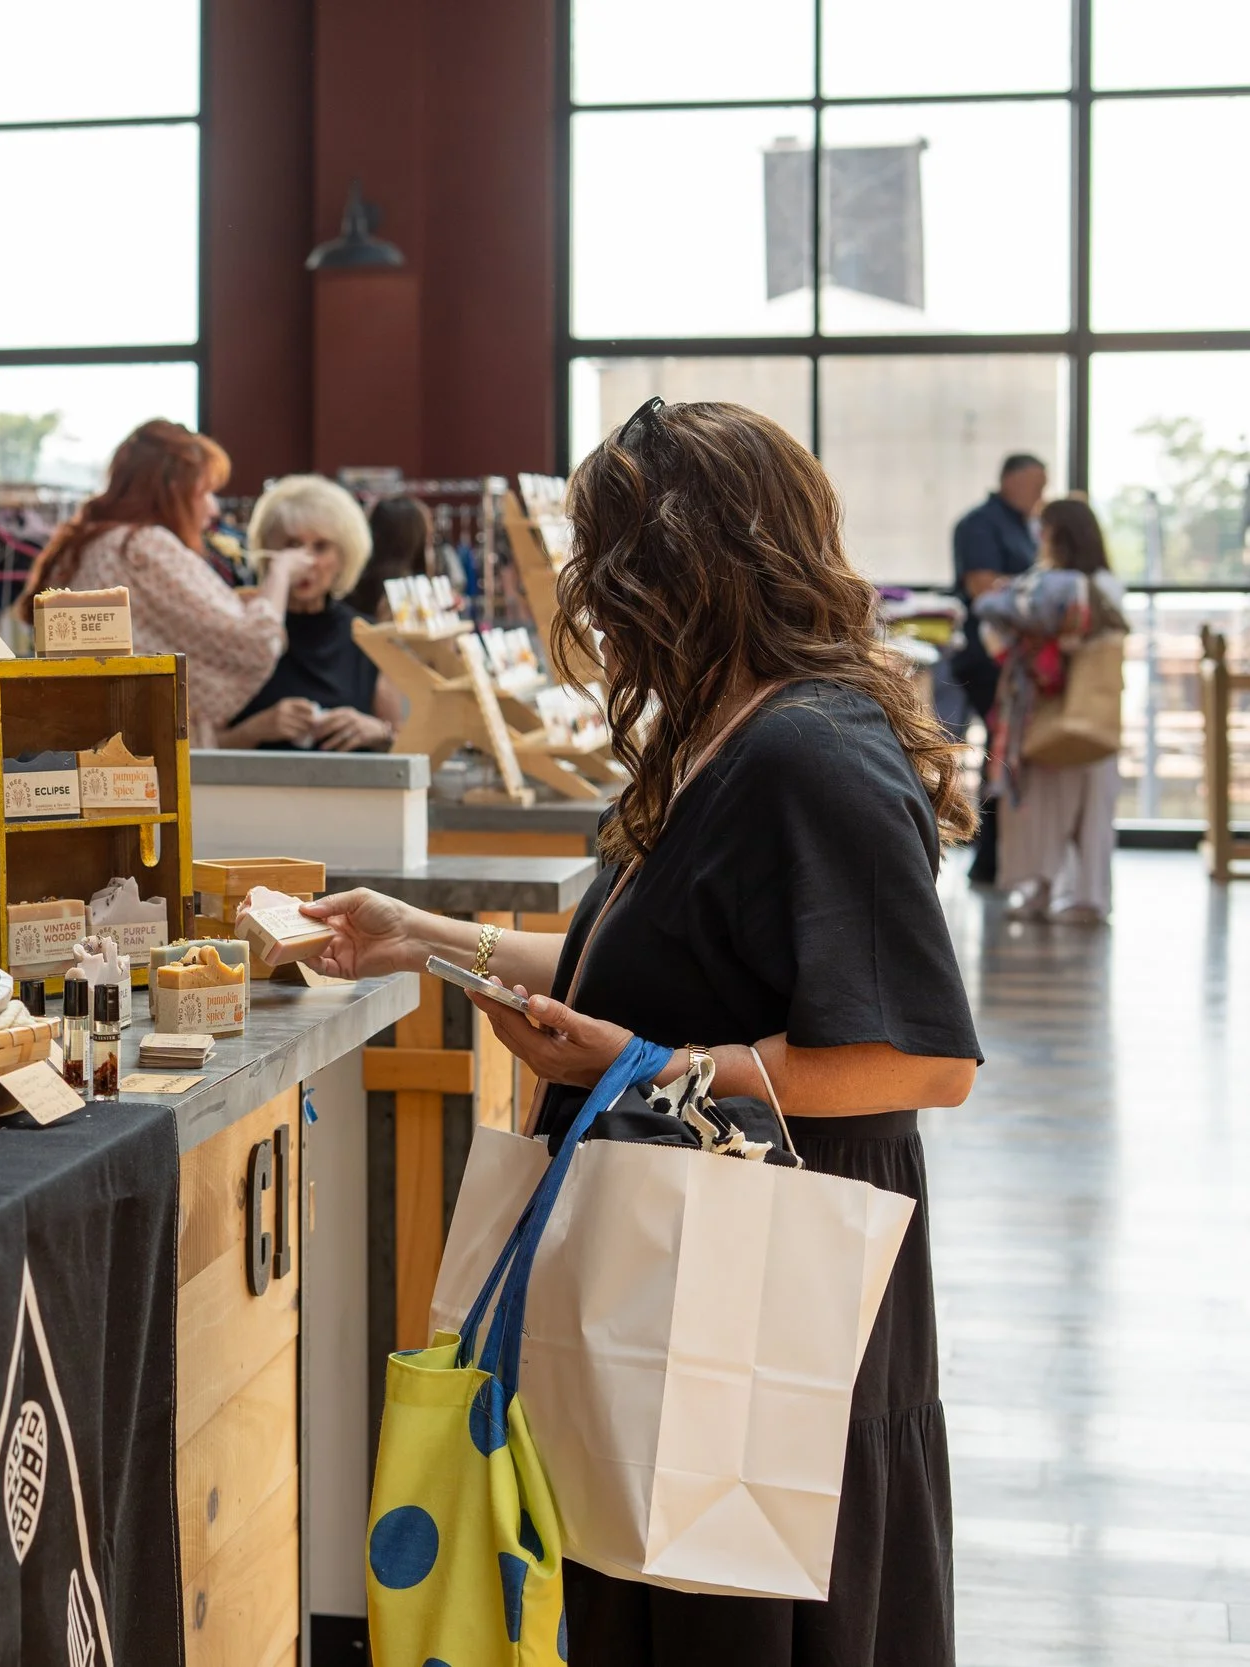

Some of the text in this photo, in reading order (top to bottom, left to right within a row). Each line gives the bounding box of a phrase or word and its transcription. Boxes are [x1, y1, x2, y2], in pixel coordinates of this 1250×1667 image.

[81, 613, 115, 622] SWEET
[50, 612, 66, 622] TREE
[68, 616, 77, 640] SOAPS
[82, 623, 101, 631] BEE
[113, 770, 148, 784] pumpkin
[6, 779, 22, 790] TREE
[23, 782, 31, 808] SOAPS
[35, 786, 70, 796] ECLIPSE
[114, 784, 134, 798] spice
[44, 922, 81, 933] VINTAGE
[123, 926, 156, 936] PURPLE
[17, 925, 32, 936] TREE
[33, 928, 41, 954] SOAPS
[44, 932, 76, 943] WOODS
[124, 937, 144, 945] RAIN
[180, 994, 195, 1004] TREE
[207, 992, 238, 1009] pumpkin
[206, 1009, 226, 1024] spice
